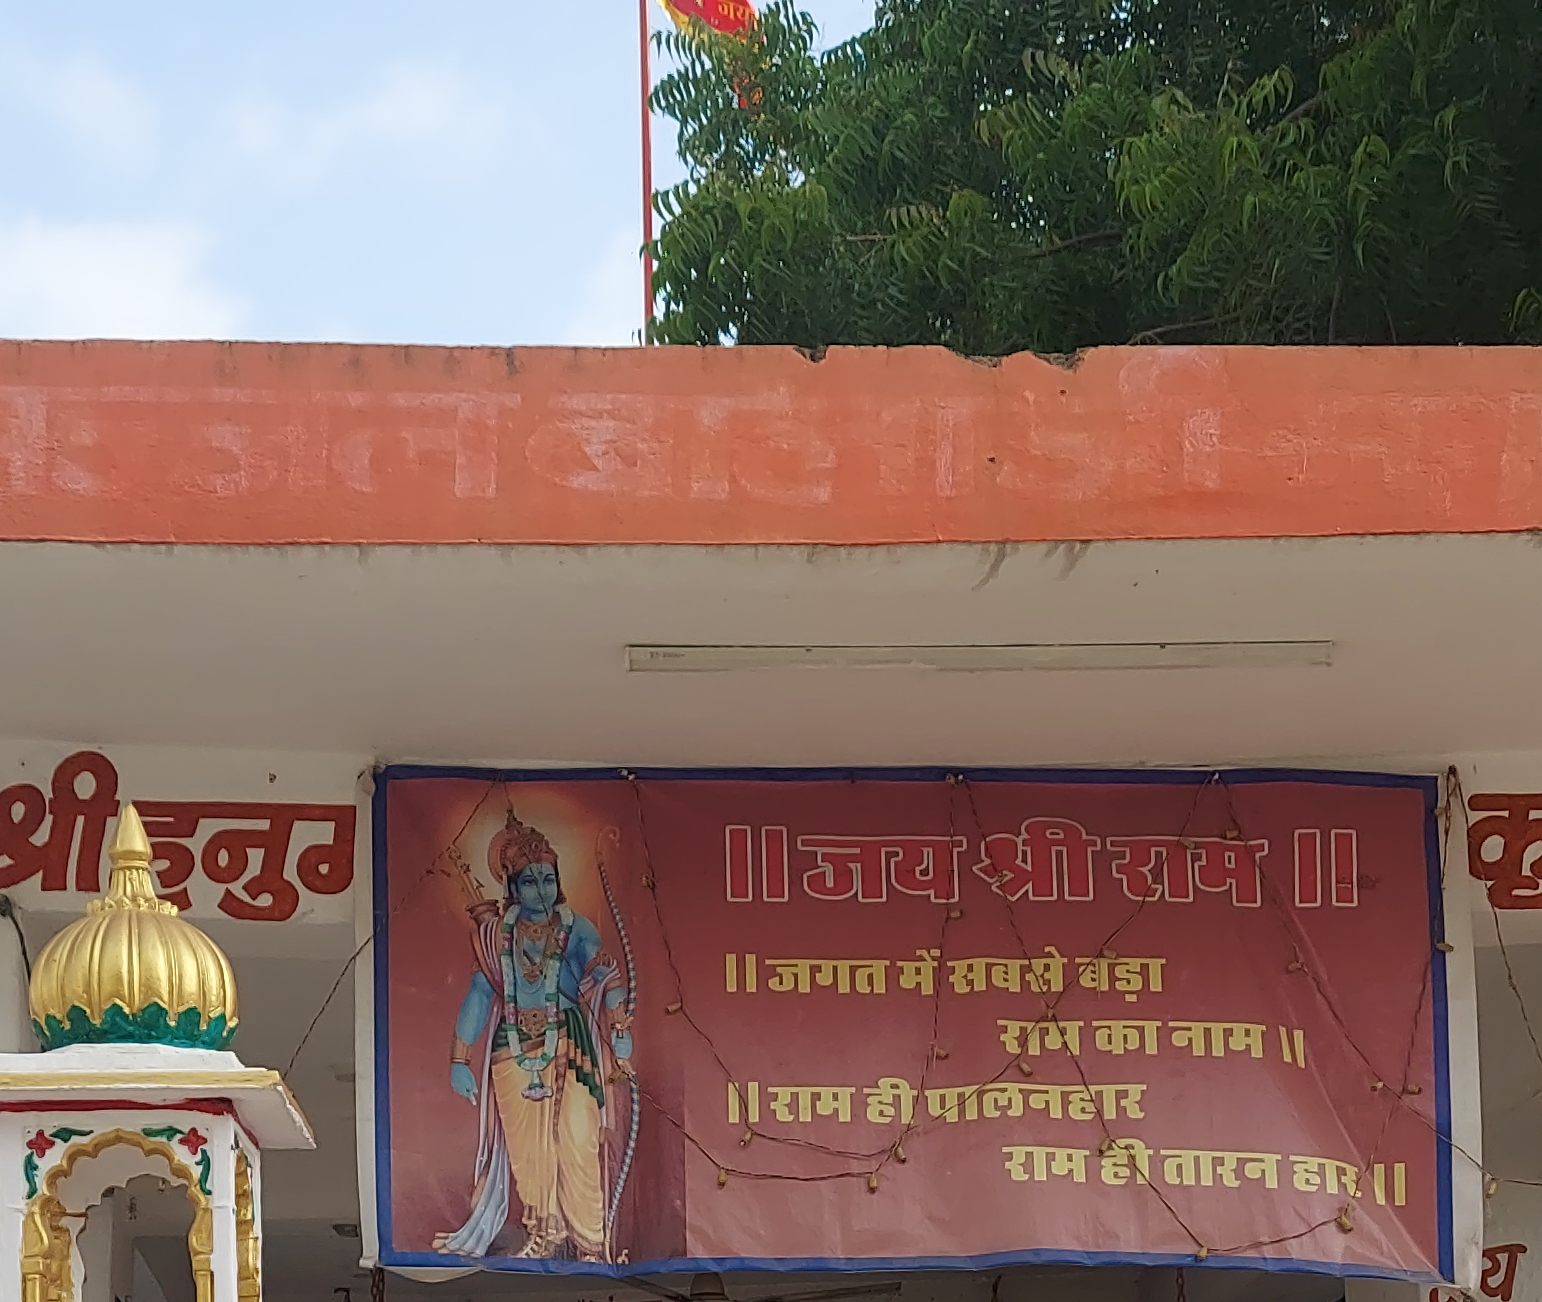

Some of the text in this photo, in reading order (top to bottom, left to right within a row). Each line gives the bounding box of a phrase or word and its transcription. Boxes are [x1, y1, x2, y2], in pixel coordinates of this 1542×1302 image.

[797, 833, 969, 905] जय
[970, 816, 1100, 904] श्री
[1104, 835, 1267, 909] राम
[765, 957, 887, 996] जगत
[947, 946, 1068, 995] सबसे
[996, 1018, 1083, 1059] राम
[1091, 1020, 1162, 1058] का
[1170, 1020, 1267, 1061] नाम
[769, 1084, 857, 1125] राम
[863, 1079, 918, 1126] ही
[1001, 1144, 1089, 1186] राम
[1160, 1149, 1284, 1191] तारन
